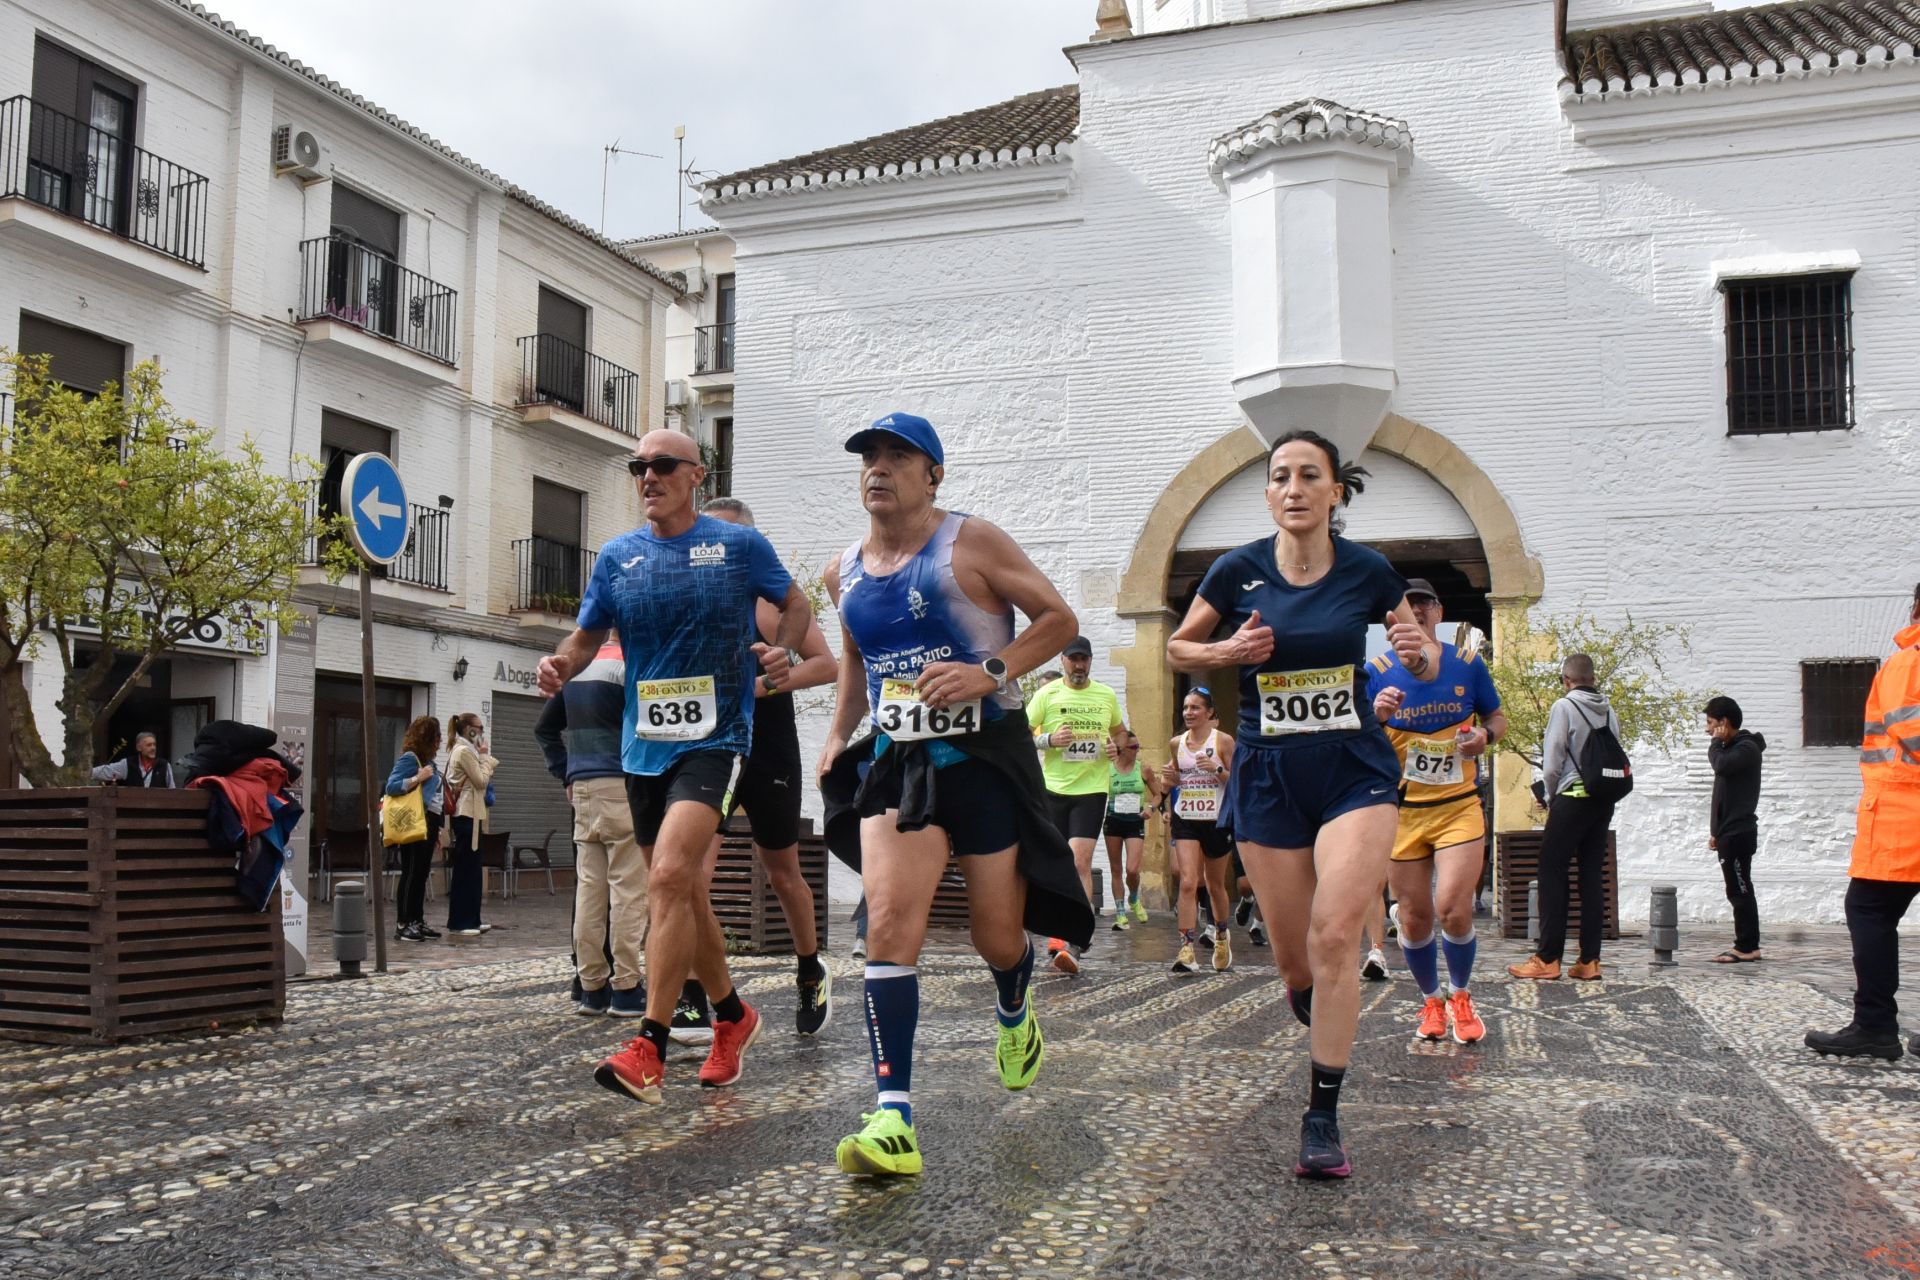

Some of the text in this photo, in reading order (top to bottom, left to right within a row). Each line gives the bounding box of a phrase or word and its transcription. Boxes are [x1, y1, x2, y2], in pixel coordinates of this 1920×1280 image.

[695, 549, 720, 557] LOJA
[870, 646, 952, 674] ZITO a PAZITO
[493, 660, 537, 689] Aboga
[1271, 675, 1288, 688] 38
[648, 700, 703, 727] 638
[1265, 690, 1352, 722] 3062
[1394, 701, 1462, 721] agustinos
[881, 704, 977, 734] 3164
[1068, 742, 1096, 755] 442
[1415, 754, 1454, 774] 675
[1180, 799, 1216, 812] 2102
[866, 991, 885, 1061] COMPRESSPORT
